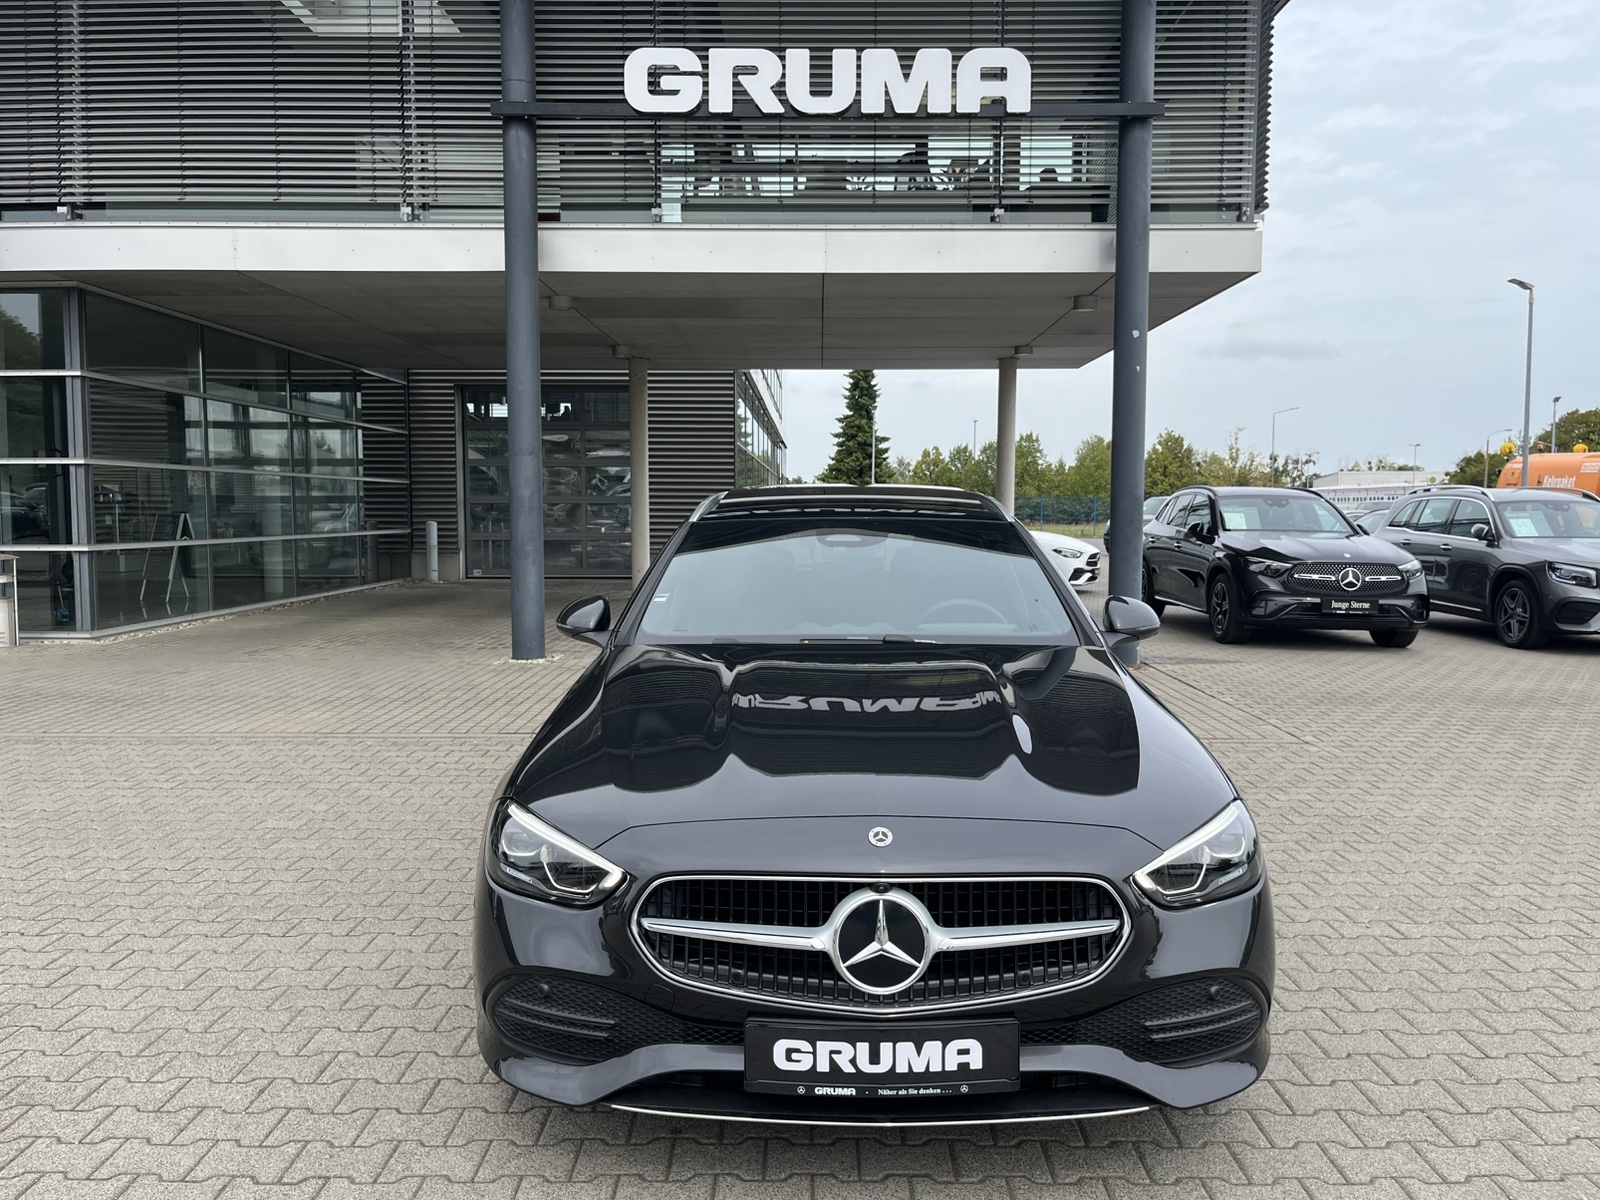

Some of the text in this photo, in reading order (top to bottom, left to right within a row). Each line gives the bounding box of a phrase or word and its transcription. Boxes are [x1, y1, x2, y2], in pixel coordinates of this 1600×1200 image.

[624, 47, 1032, 114] GRUMA
[1331, 600, 1370, 610] Junge Sterne
[772, 1038, 983, 1074] GRUMA
[814, 1086, 857, 1096] GRUMA
[908, 1087, 918, 1095] Sie
